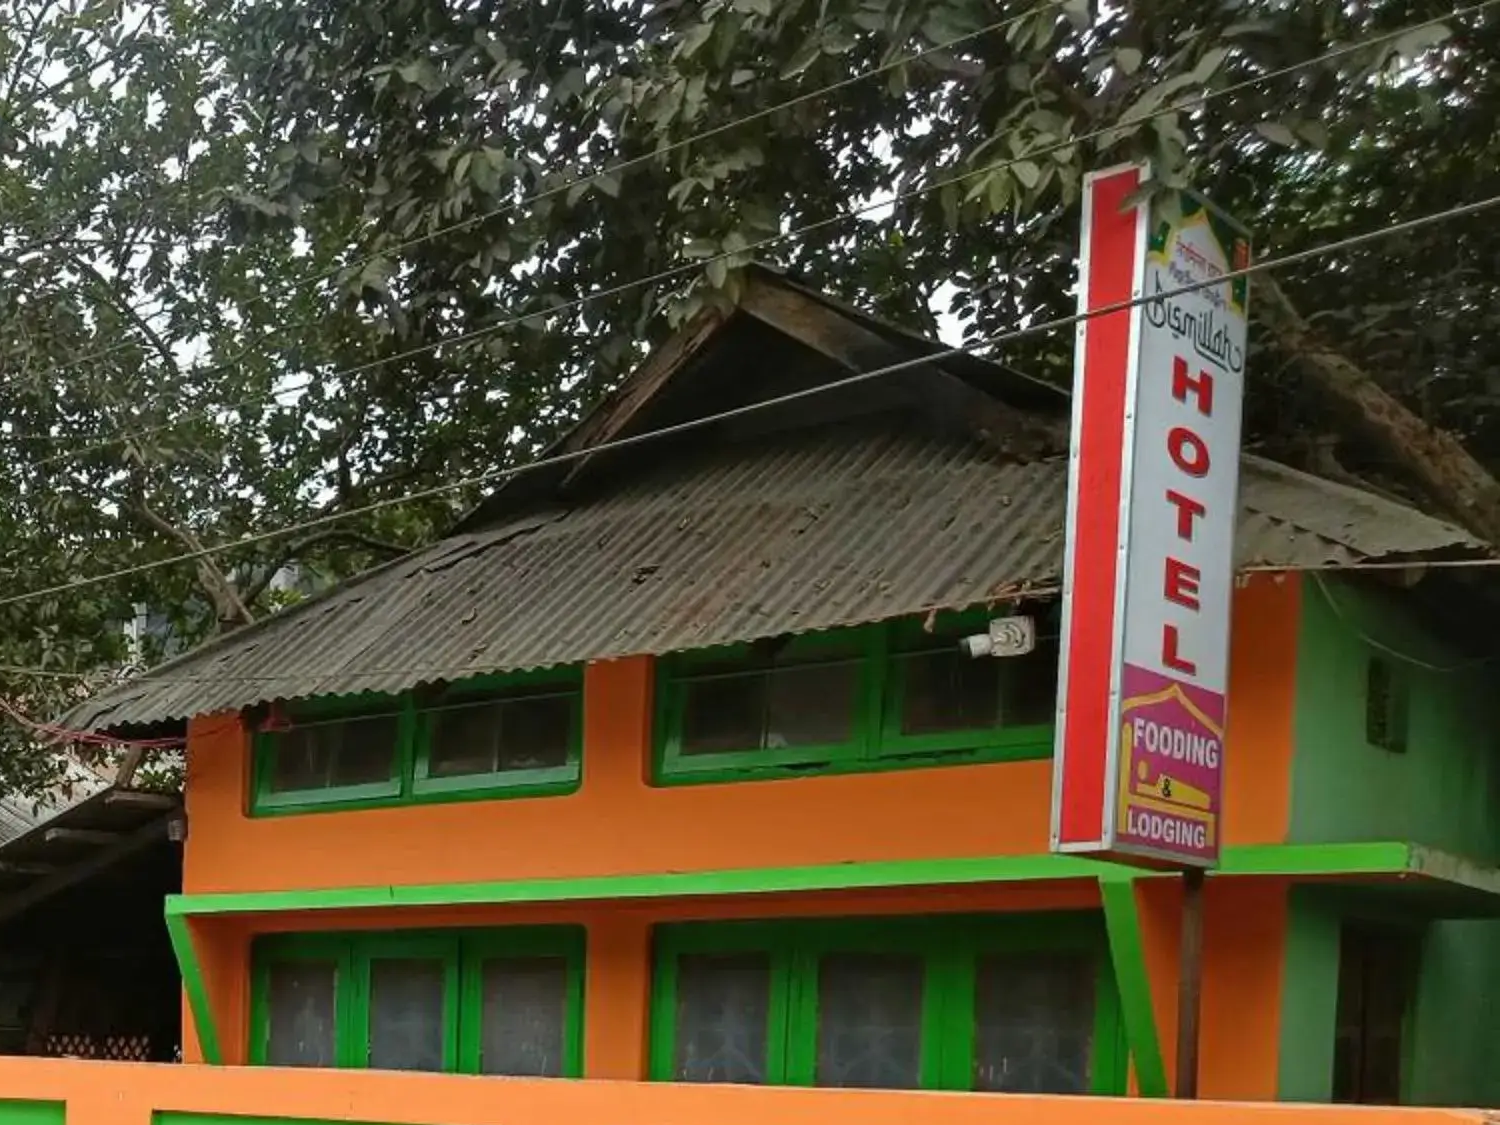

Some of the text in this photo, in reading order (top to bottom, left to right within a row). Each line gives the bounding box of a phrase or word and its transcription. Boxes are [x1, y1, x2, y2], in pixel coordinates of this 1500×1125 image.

[1162, 355, 1214, 676] HOTEL
[1133, 717, 1219, 769] FOODING
[1161, 778, 1172, 798] &
[1126, 809, 1205, 848] LODGING
